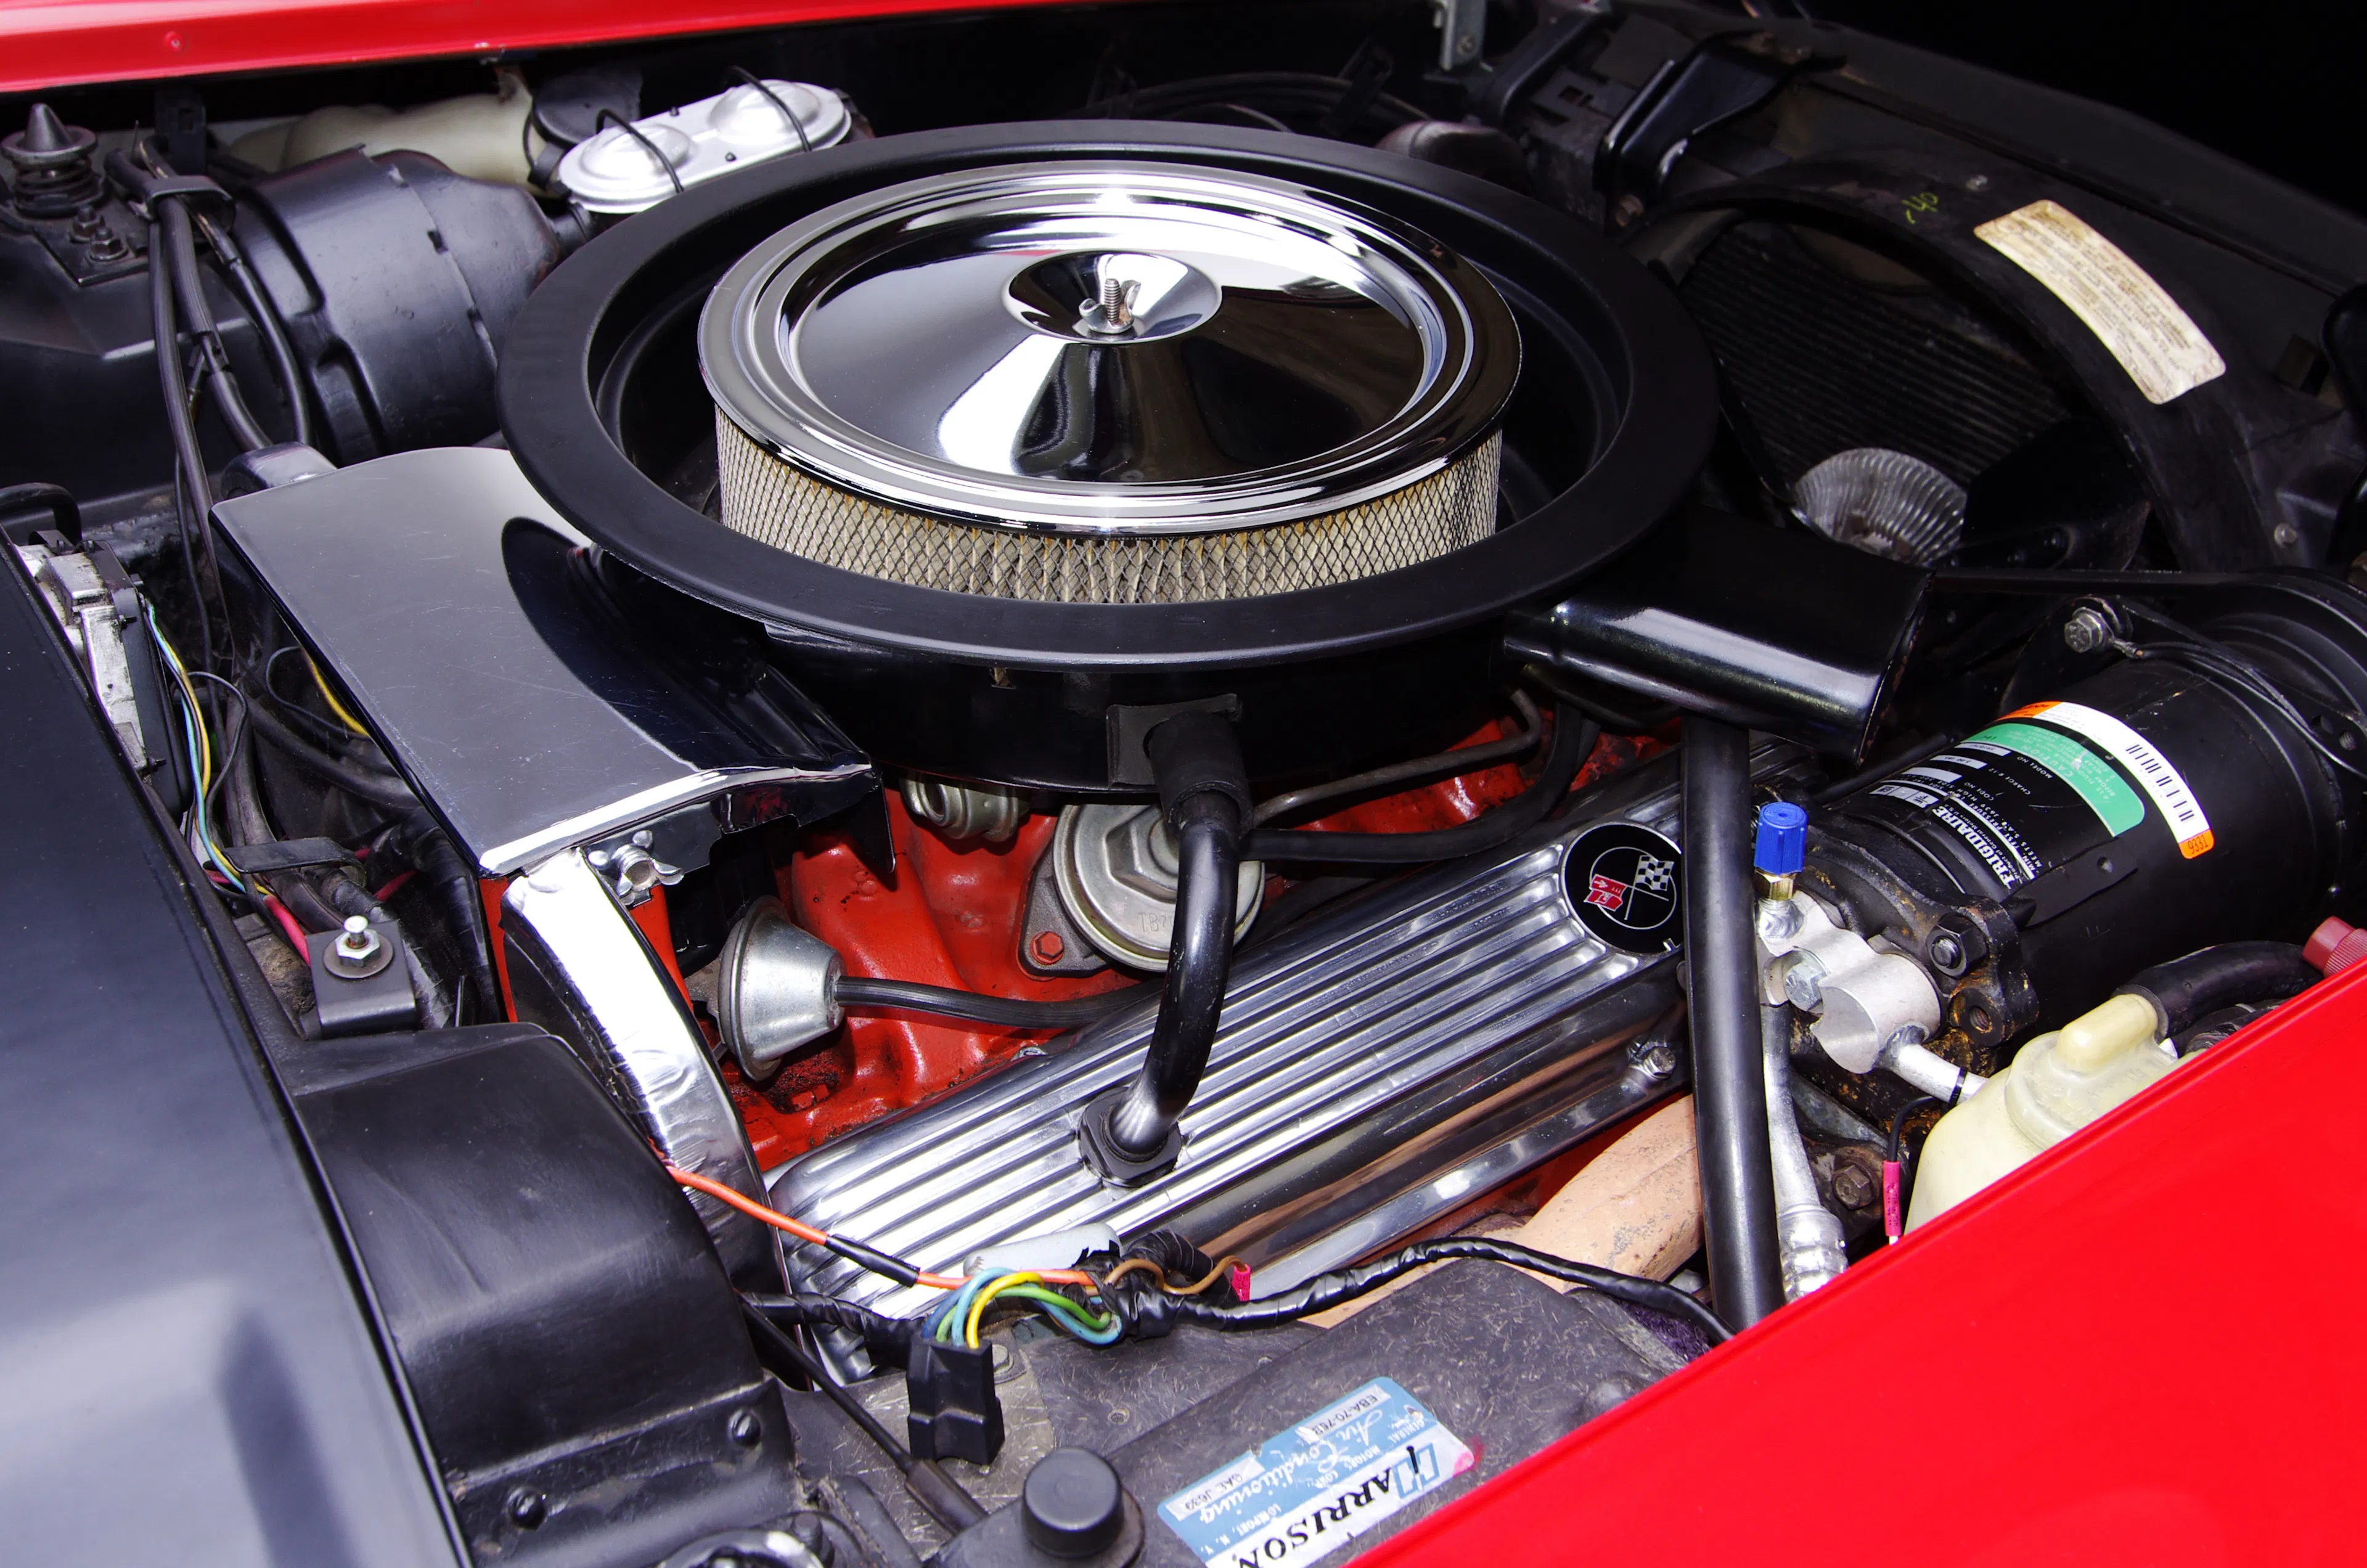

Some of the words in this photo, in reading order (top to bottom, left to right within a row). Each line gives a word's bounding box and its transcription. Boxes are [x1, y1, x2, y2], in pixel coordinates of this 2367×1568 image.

[2019, 743, 2074, 777] CAUTION
[2029, 761, 2053, 778] MODEL
[1937, 778, 1955, 789] SIDE
[1957, 786, 1978, 801] HIGH
[2005, 775, 2032, 795] CHARGE
[1976, 787, 1995, 801] CODE
[1968, 801, 2003, 830] PRESSURE
[1979, 801, 2000, 817] J639
[1958, 813, 1978, 830] Motors
[1931, 805, 2016, 889] FRIGIDAIRE
[1976, 828, 1997, 849] General
[2003, 831, 2020, 849] TEST
[2187, 834, 2209, 854] 9331
[1995, 847, 2004, 857] of
[2019, 840, 2043, 867] MEETS
[2020, 852, 2036, 870] MIN.
[2000, 854, 2021, 879] Product
[1335, 1408, 1382, 1447] Air
[1386, 1416, 1425, 1445] GENERAL
[1342, 1443, 1381, 1472] MOTORS
[1200, 1437, 1338, 1524] Conditioning
